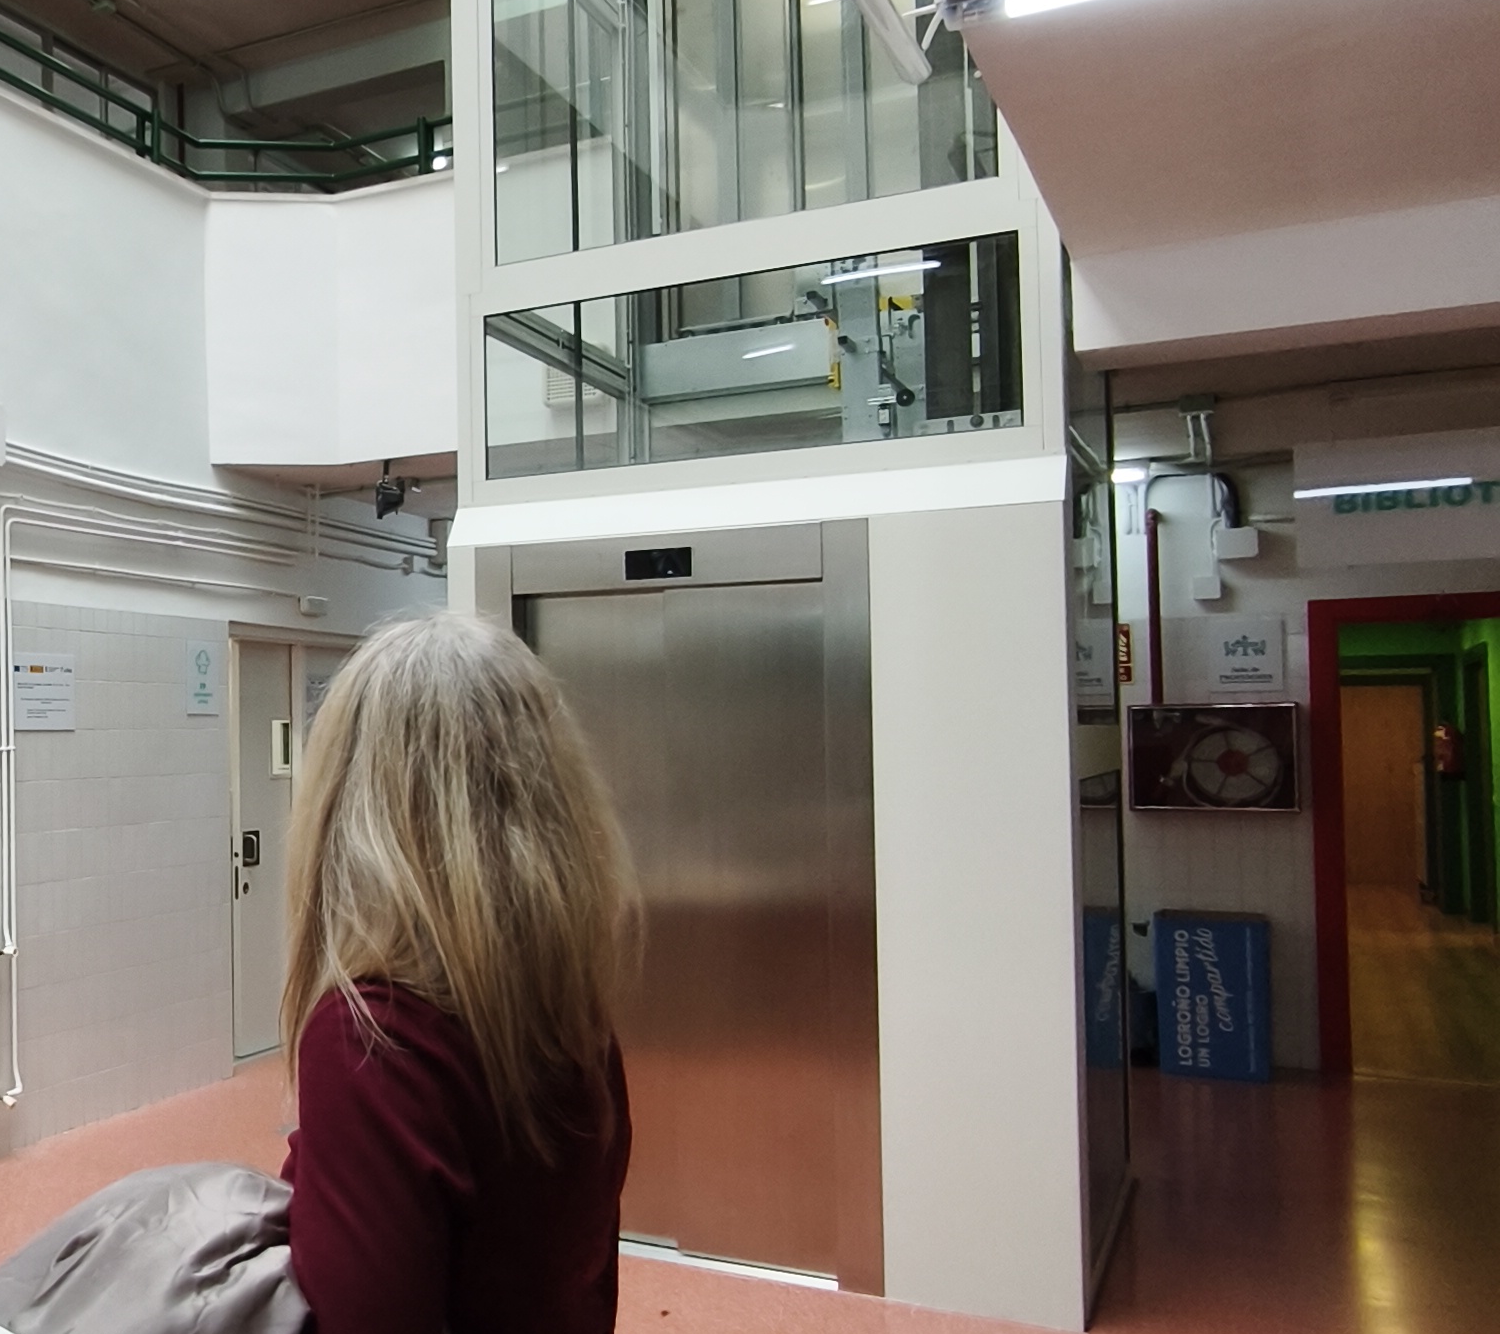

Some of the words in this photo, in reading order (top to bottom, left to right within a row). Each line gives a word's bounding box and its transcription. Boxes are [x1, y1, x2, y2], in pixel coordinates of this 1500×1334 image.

[1173, 929, 1191, 983] LIMPIO
[1192, 927, 1235, 1032] compartido
[1171, 984, 1193, 1066] LOGROÑO
[1196, 994, 1210, 1043] LOGRO
[1198, 1047, 1211, 1068] UN
